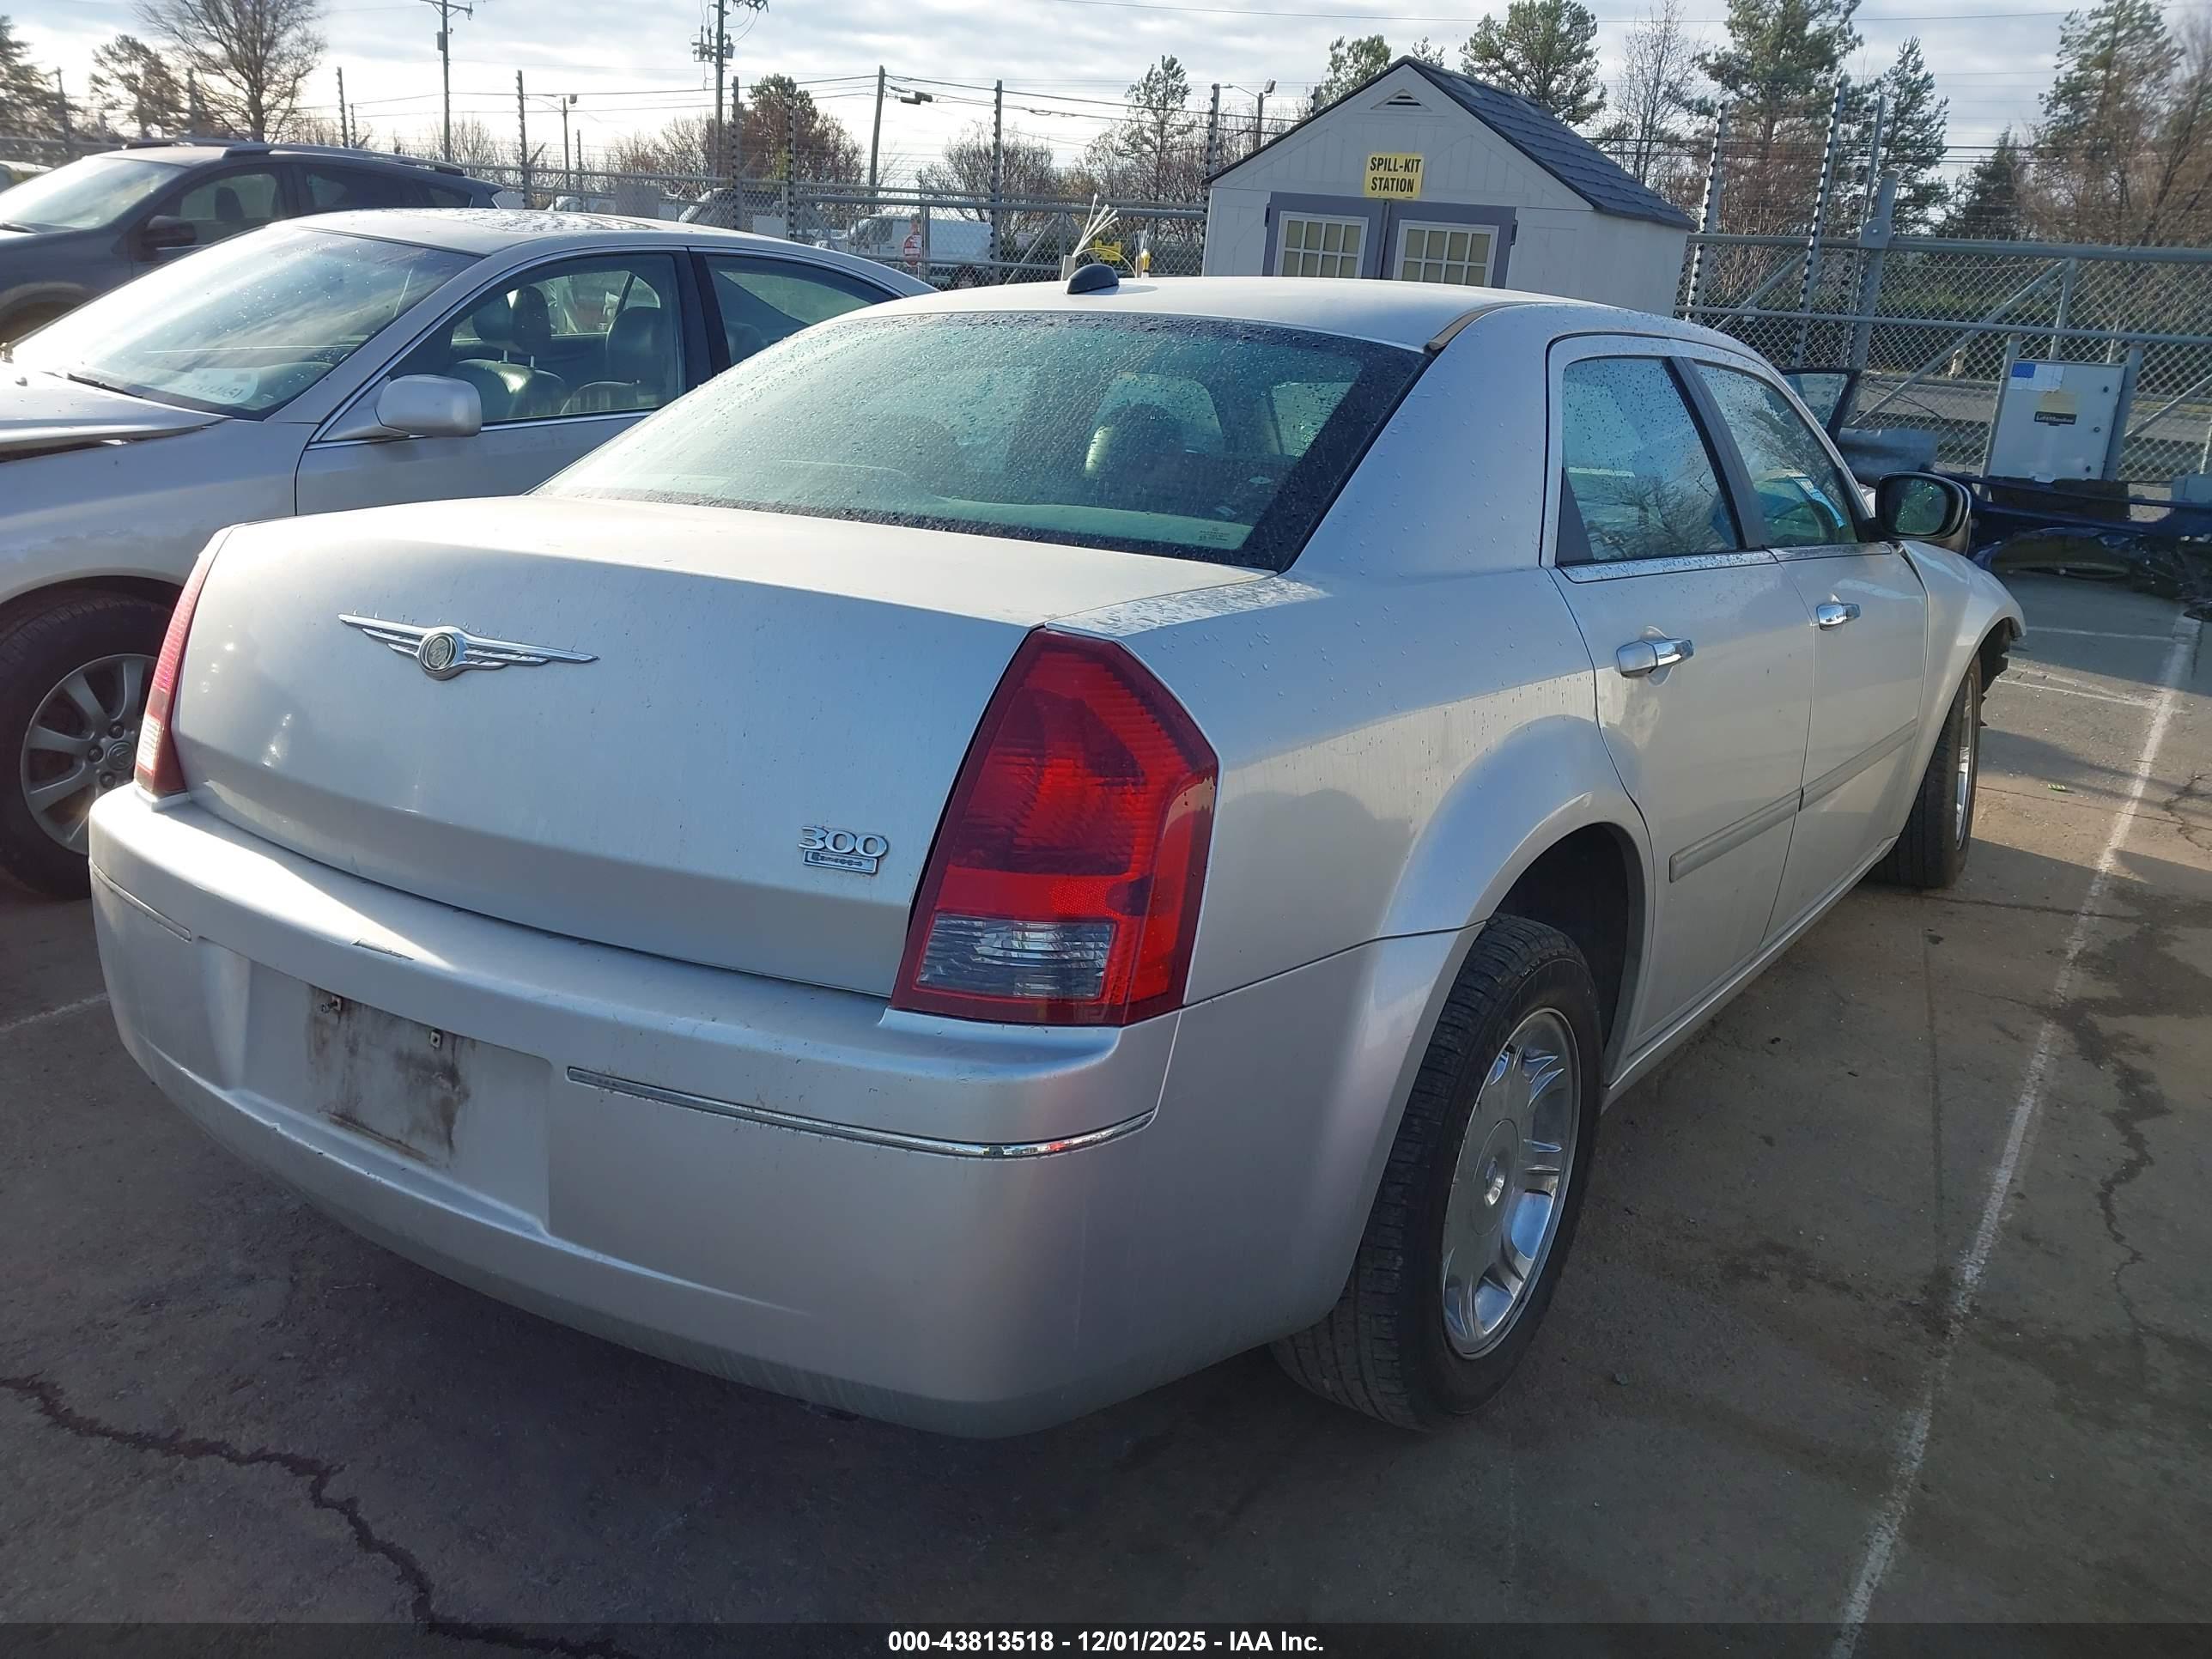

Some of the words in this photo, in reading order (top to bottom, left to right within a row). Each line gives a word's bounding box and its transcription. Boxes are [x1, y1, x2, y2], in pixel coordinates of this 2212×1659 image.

[1370, 156, 1422, 173] SPILL-KIT
[1370, 176, 1415, 192] STATION
[798, 825, 888, 858] 300
